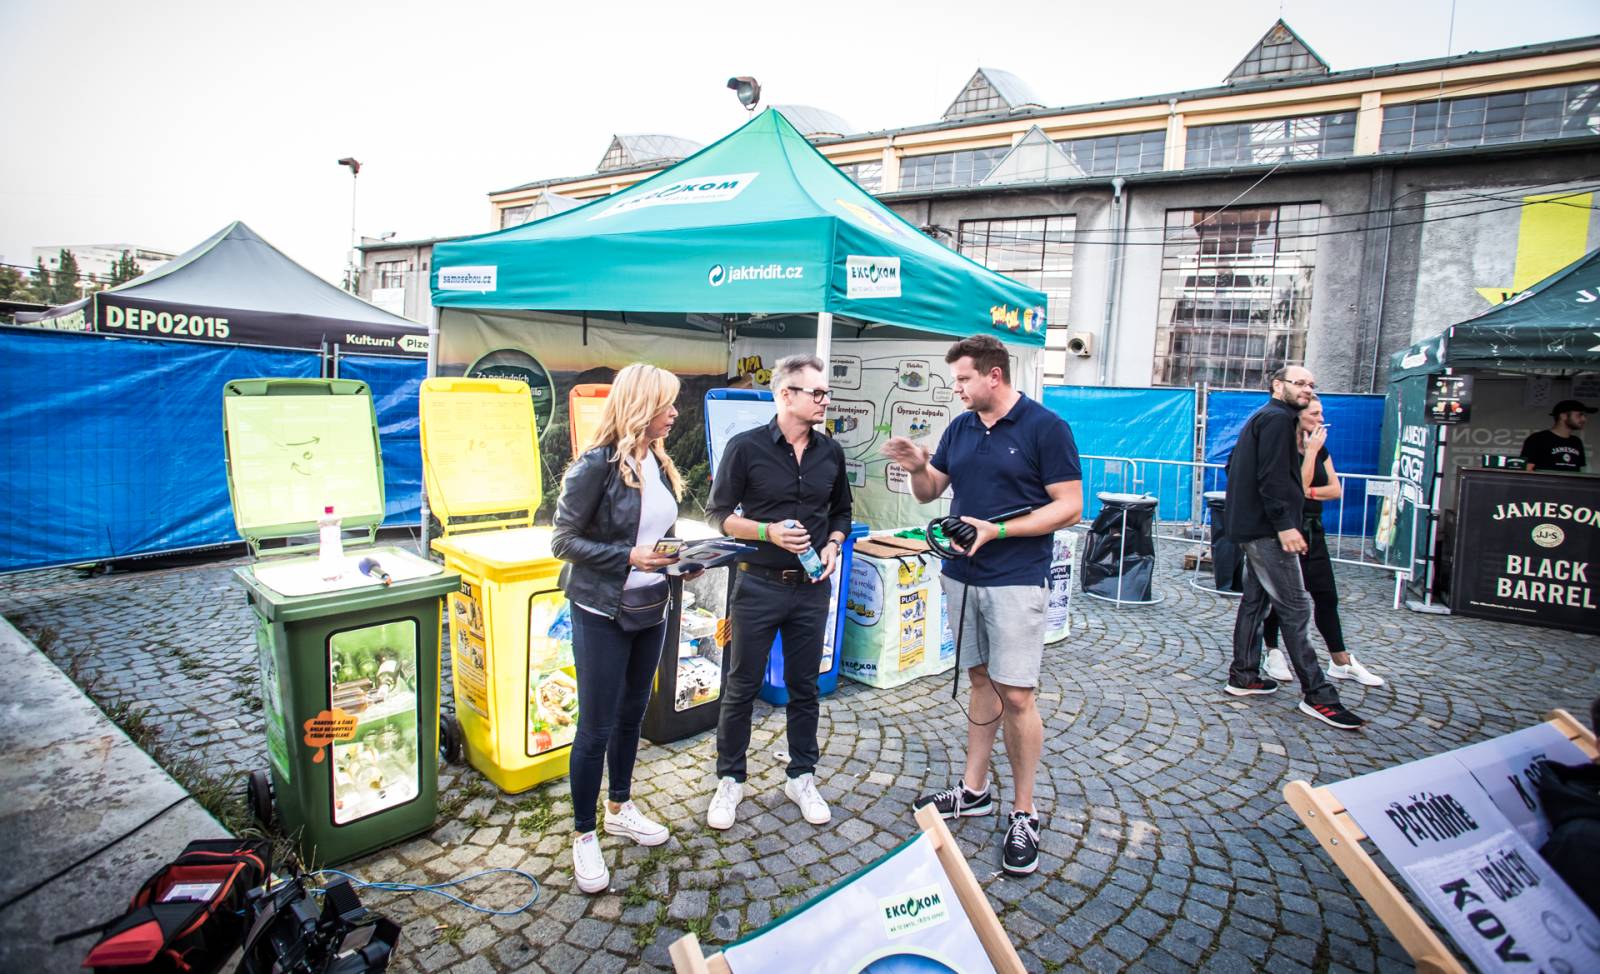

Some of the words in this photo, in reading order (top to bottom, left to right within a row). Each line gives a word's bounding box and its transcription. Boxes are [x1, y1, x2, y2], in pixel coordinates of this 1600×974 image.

[443, 273, 491, 284] samosebou.cz
[728, 265, 803, 283] jaktridit.cz
[105, 304, 229, 339] DEPO2015
[346, 334, 396, 347] Kulturní
[407, 339, 429, 349] Plze
[1506, 554, 1588, 583] BLACK
[1497, 577, 1597, 609] BARREL
[1439, 878, 1545, 974] KOV
